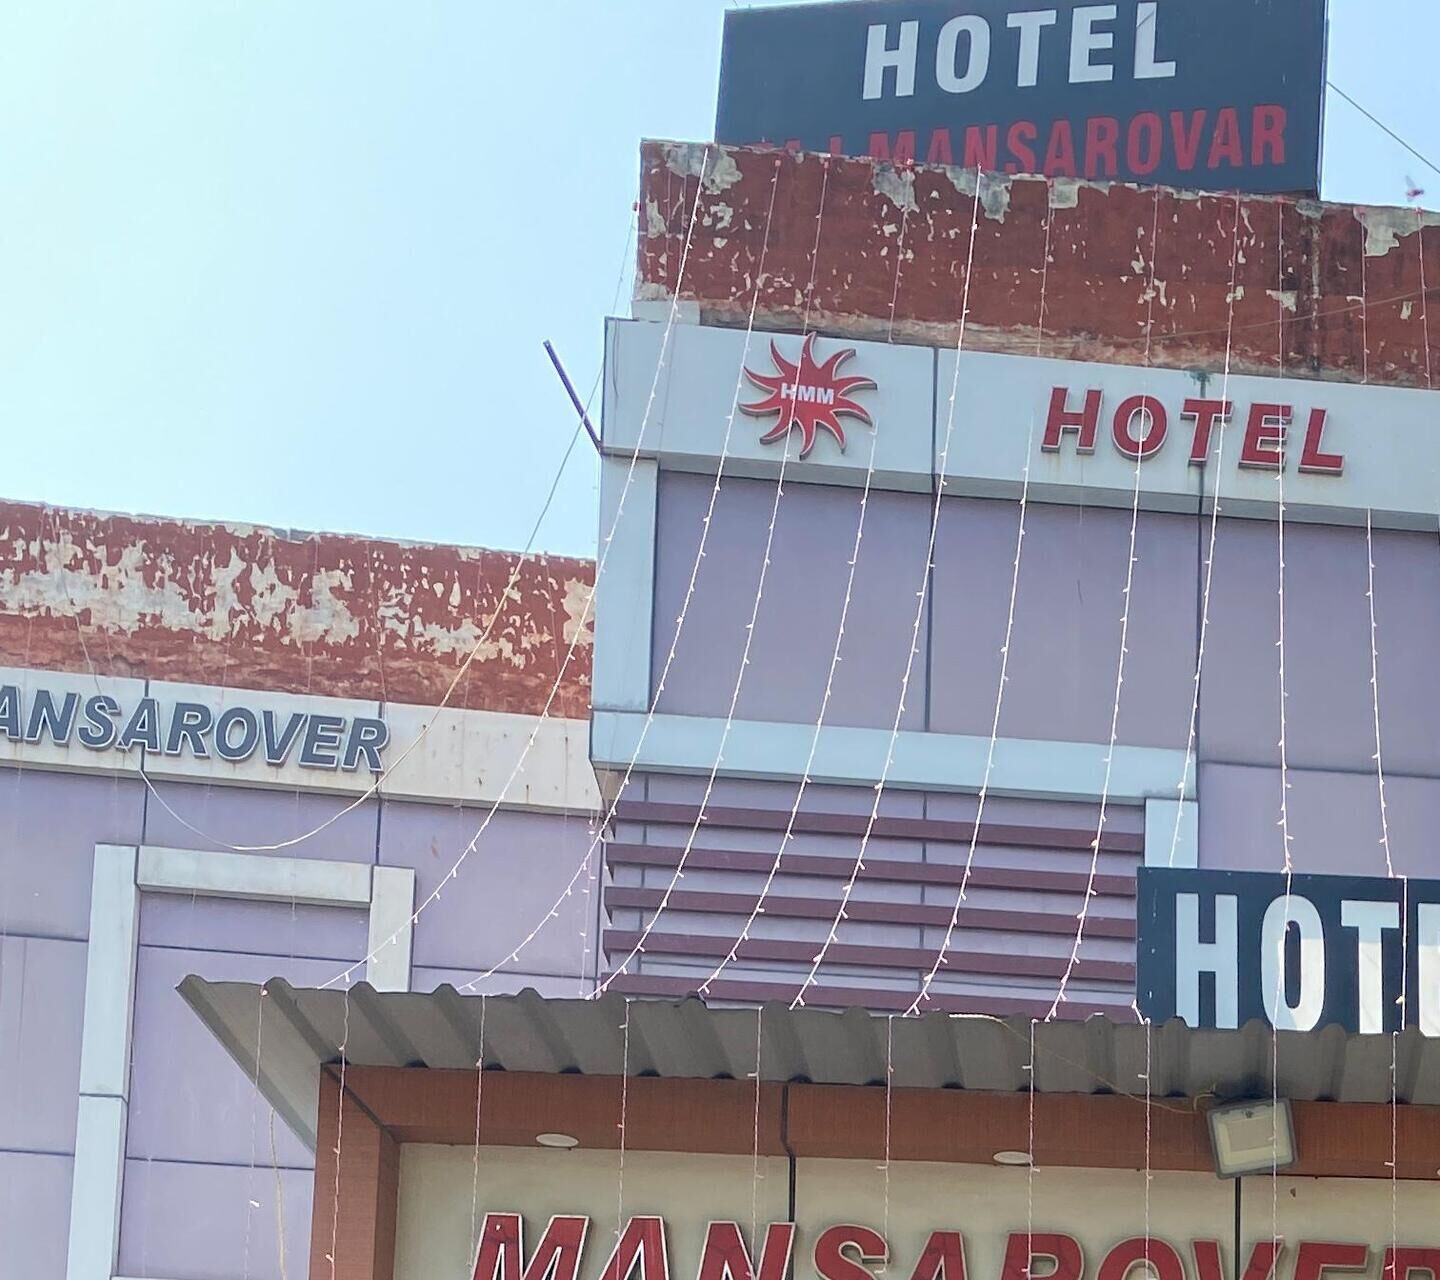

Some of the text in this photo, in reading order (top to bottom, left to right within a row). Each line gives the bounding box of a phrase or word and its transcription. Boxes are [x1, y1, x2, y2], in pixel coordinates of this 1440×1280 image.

[862, 2, 1177, 100] HOTEL
[781, 383, 834, 405] HMM
[1041, 386, 1345, 476] HOTEL
